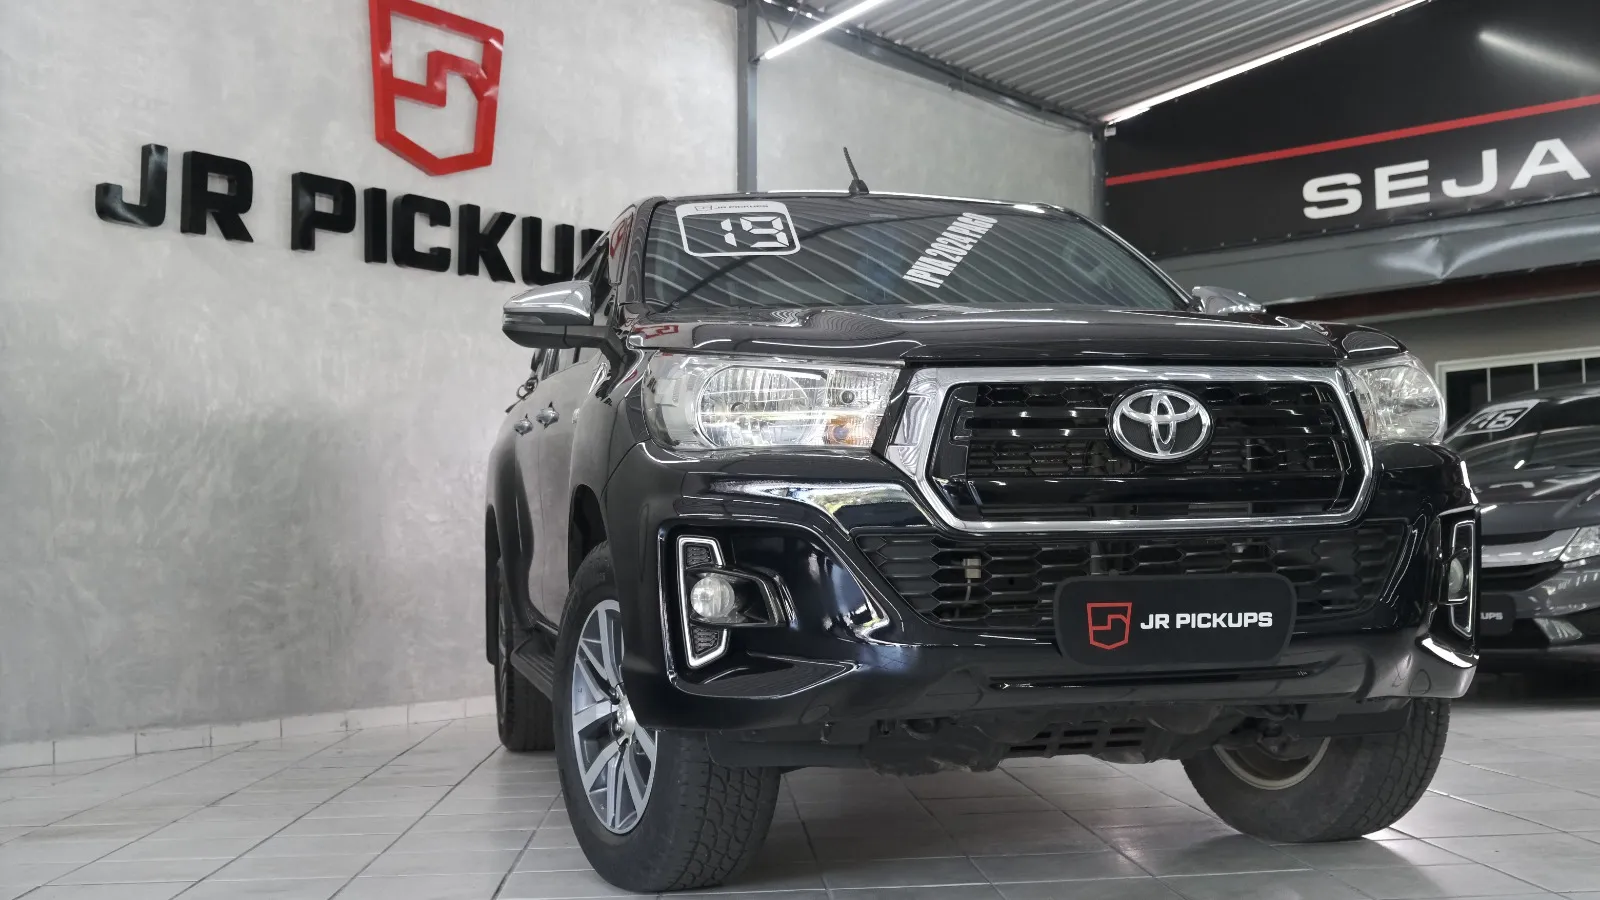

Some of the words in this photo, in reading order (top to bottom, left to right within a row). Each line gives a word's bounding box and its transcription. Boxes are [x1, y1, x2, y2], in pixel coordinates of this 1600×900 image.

[95, 143, 254, 243] JR
[1302, 137, 1591, 220] SEJA
[720, 216, 790, 248] 19
[946, 212, 998, 239] PAGO
[924, 231, 978, 263] 2024
[902, 255, 958, 288] IPVA
[1140, 613, 1170, 630] JR
[1175, 611, 1273, 629] PICKUPS
